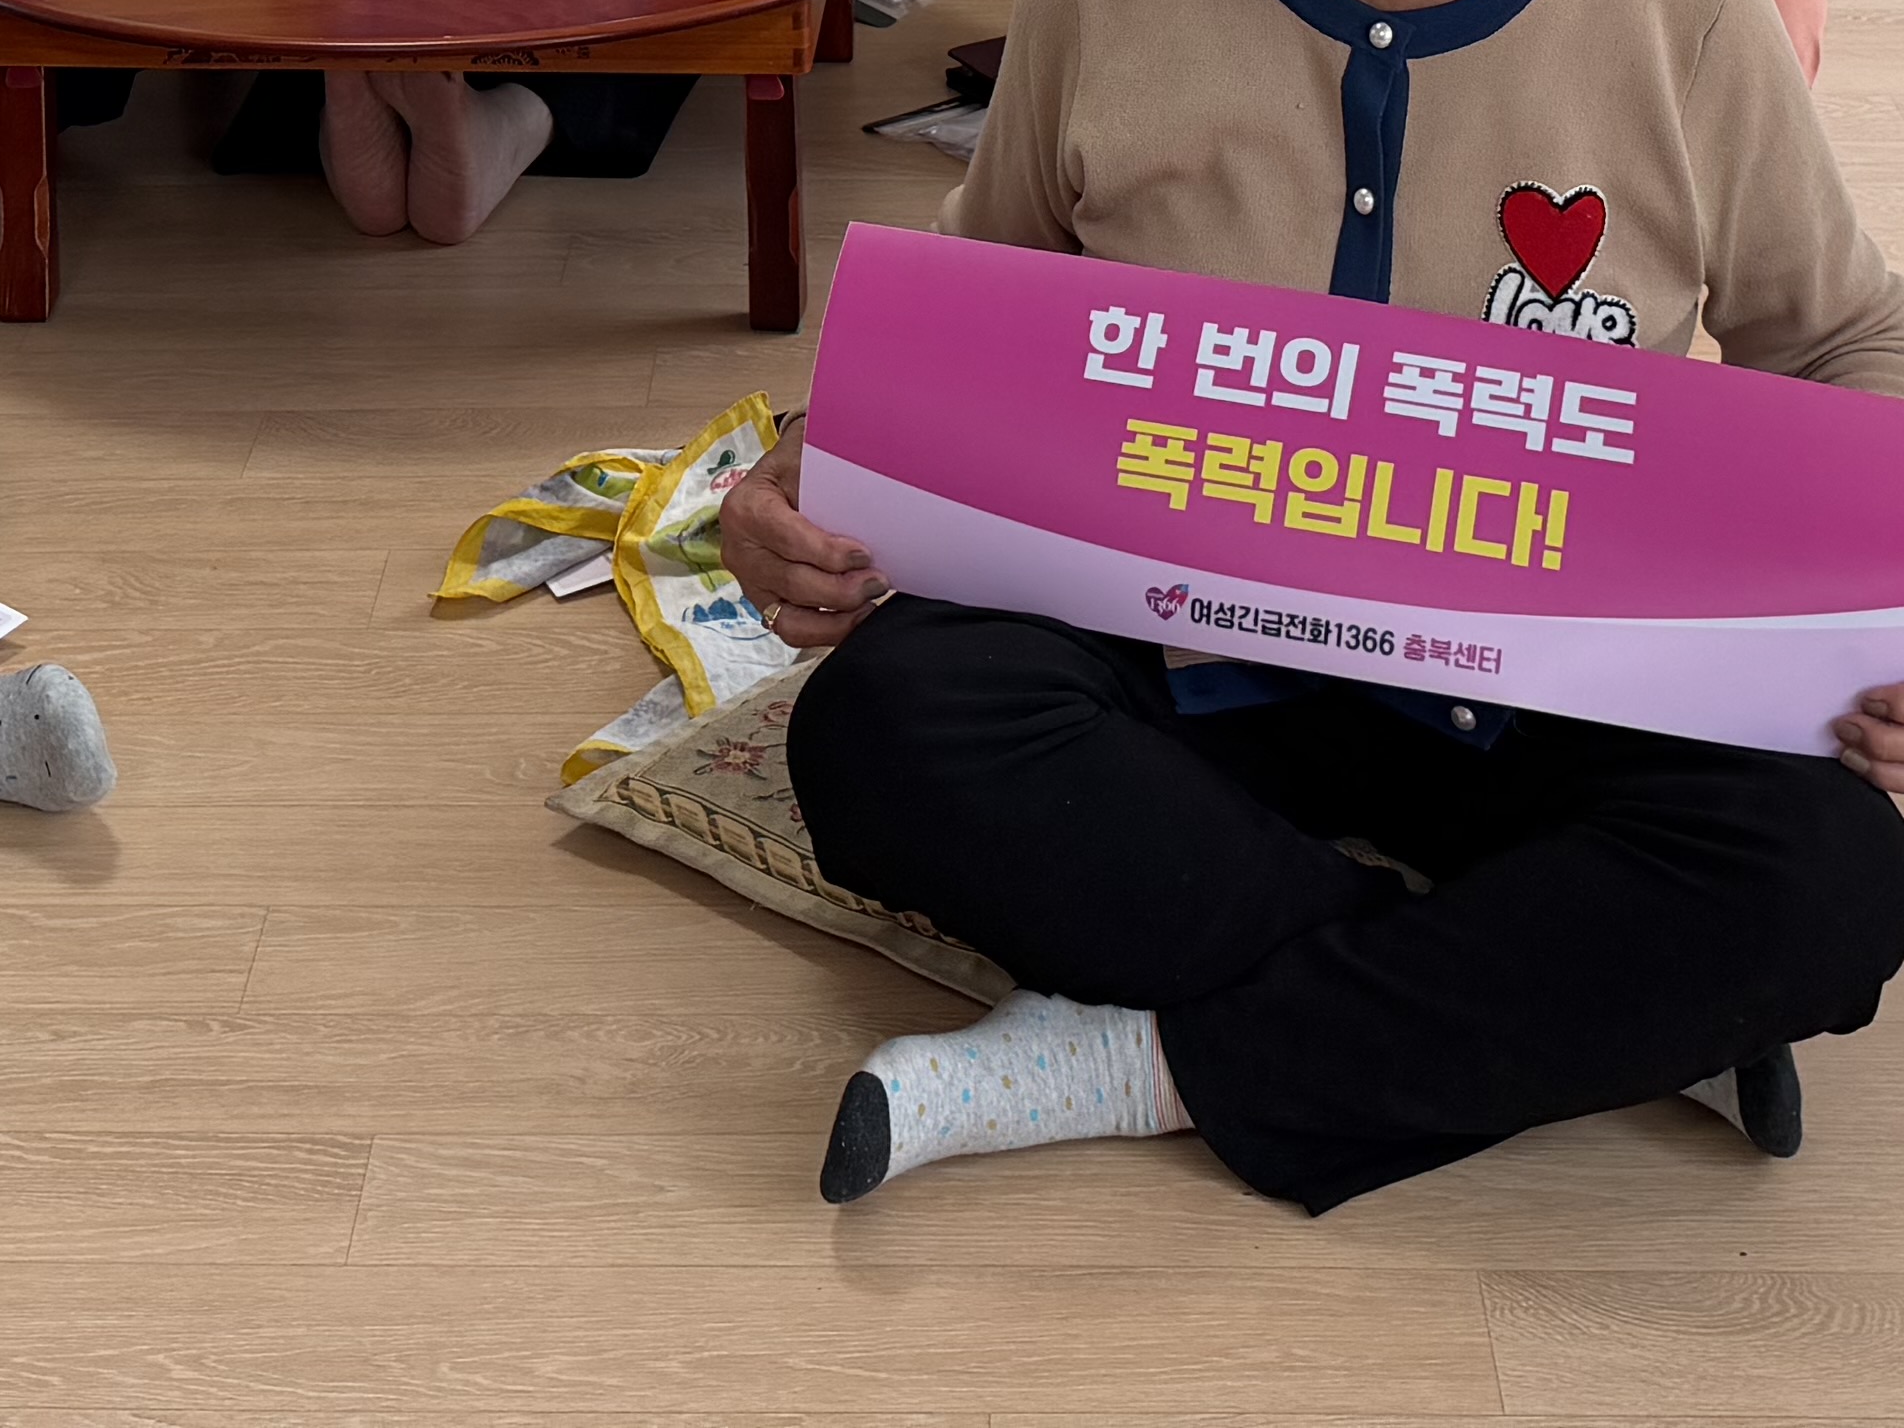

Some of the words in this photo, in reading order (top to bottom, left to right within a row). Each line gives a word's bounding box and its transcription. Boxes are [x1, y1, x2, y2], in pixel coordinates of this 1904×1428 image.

[1083, 304, 1167, 392] 한
[1191, 320, 1358, 422] 번의
[1381, 347, 1638, 466] 폭력도
[1115, 417, 1570, 573] 폭력입니다!
[1188, 594, 1397, 659] 여성긴급전화1366
[1401, 630, 1503, 678] 충북센터
